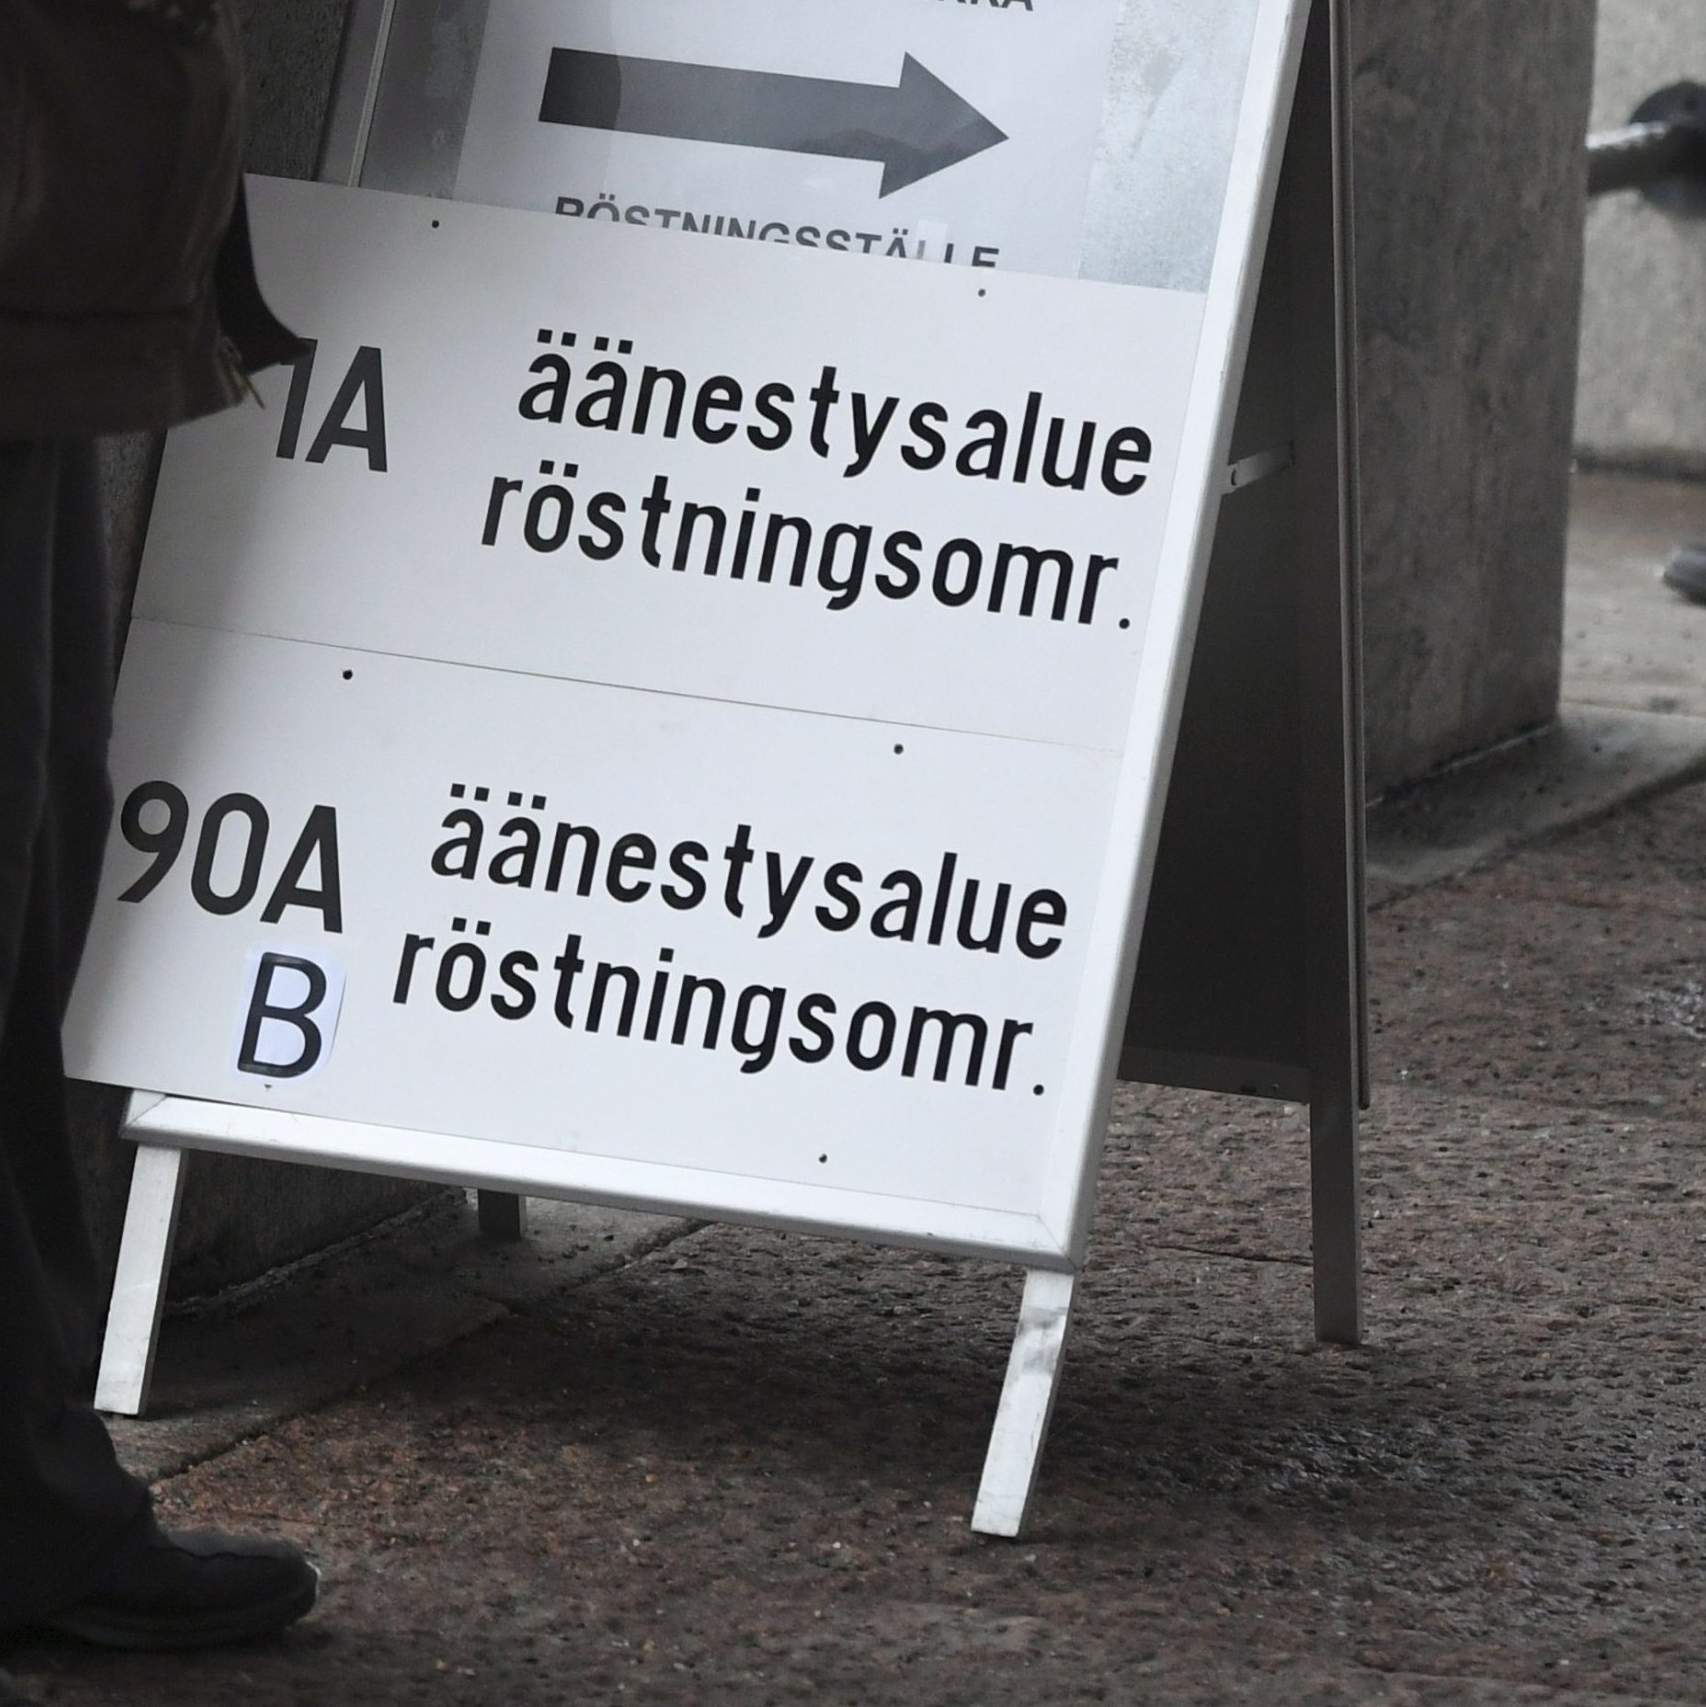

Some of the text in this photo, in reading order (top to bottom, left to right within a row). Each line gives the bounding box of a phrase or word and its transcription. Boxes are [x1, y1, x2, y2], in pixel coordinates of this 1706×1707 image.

[518, 328, 1152, 496] äänestysalue
[481, 459, 1131, 630] röstningsomr.
[116, 780, 343, 934] 90A
[431, 783, 1067, 960] äänestysalue
[237, 952, 327, 1078] B
[393, 917, 1045, 1097] röstningsomr.
